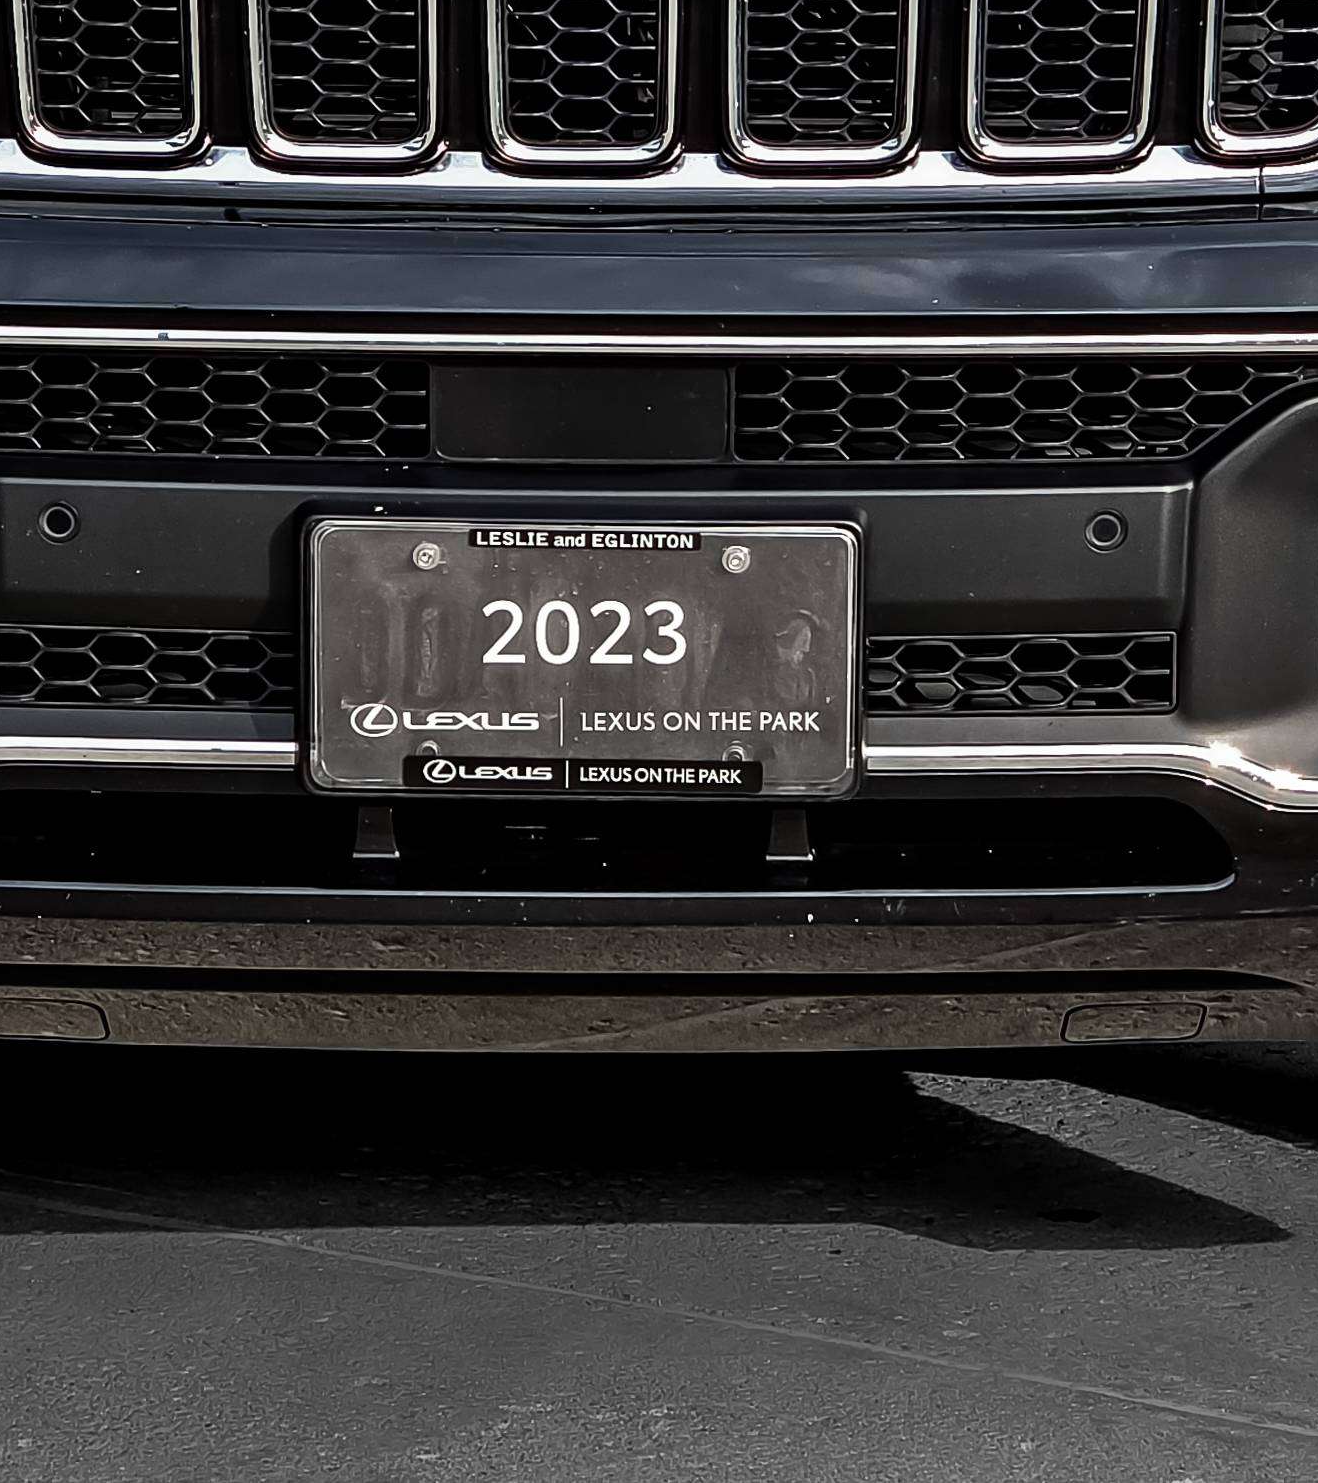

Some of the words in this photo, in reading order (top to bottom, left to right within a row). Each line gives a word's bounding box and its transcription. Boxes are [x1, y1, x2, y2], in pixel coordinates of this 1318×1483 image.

[476, 531, 549, 546] LESLIE
[553, 533, 586, 547] and
[591, 533, 694, 549] EGLINTON
[482, 599, 687, 665] 2023
[402, 711, 540, 731] LEXUS
[581, 711, 656, 732] LEXUS
[663, 711, 701, 731] ON
[708, 711, 752, 731] THE
[759, 711, 820, 732] PARK
[458, 765, 553, 781] LEXUS
[579, 766, 632, 783] LEXUS
[634, 767, 662, 784] ON
[664, 768, 696, 784] THE
[698, 768, 742, 784] PARK
